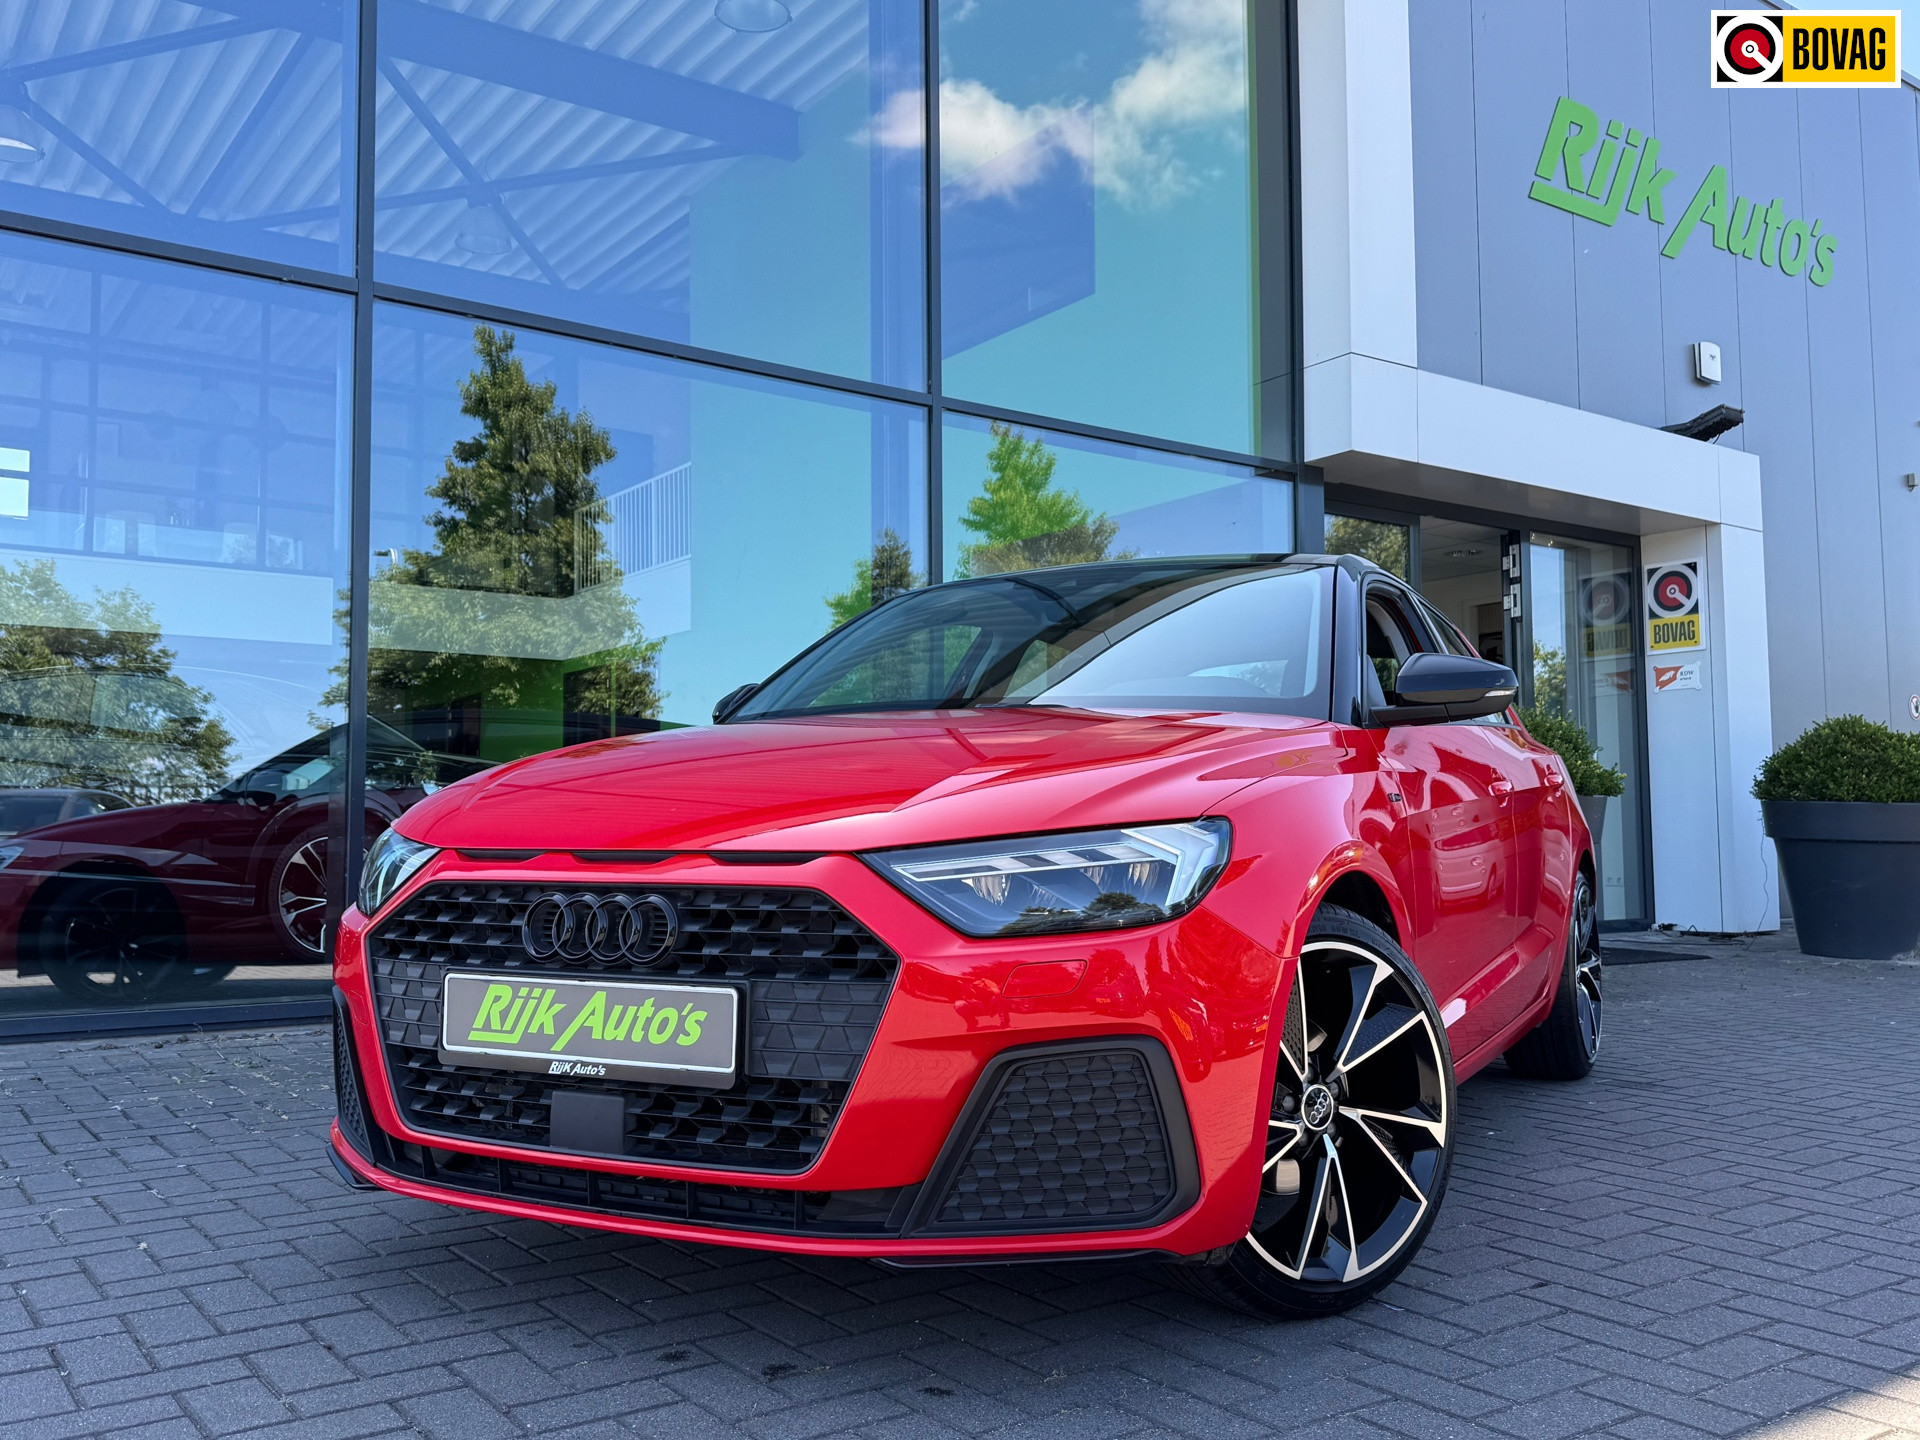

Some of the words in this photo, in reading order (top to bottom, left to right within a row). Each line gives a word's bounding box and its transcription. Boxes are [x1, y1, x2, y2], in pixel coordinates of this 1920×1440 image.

[1528, 96, 1678, 227] Rijk
[1660, 164, 1839, 287] Auto's
[1653, 620, 1696, 645] BOVAG
[467, 983, 567, 1044] Rijk
[550, 990, 708, 1052] Auto's
[569, 1062, 607, 1076] Auto's
